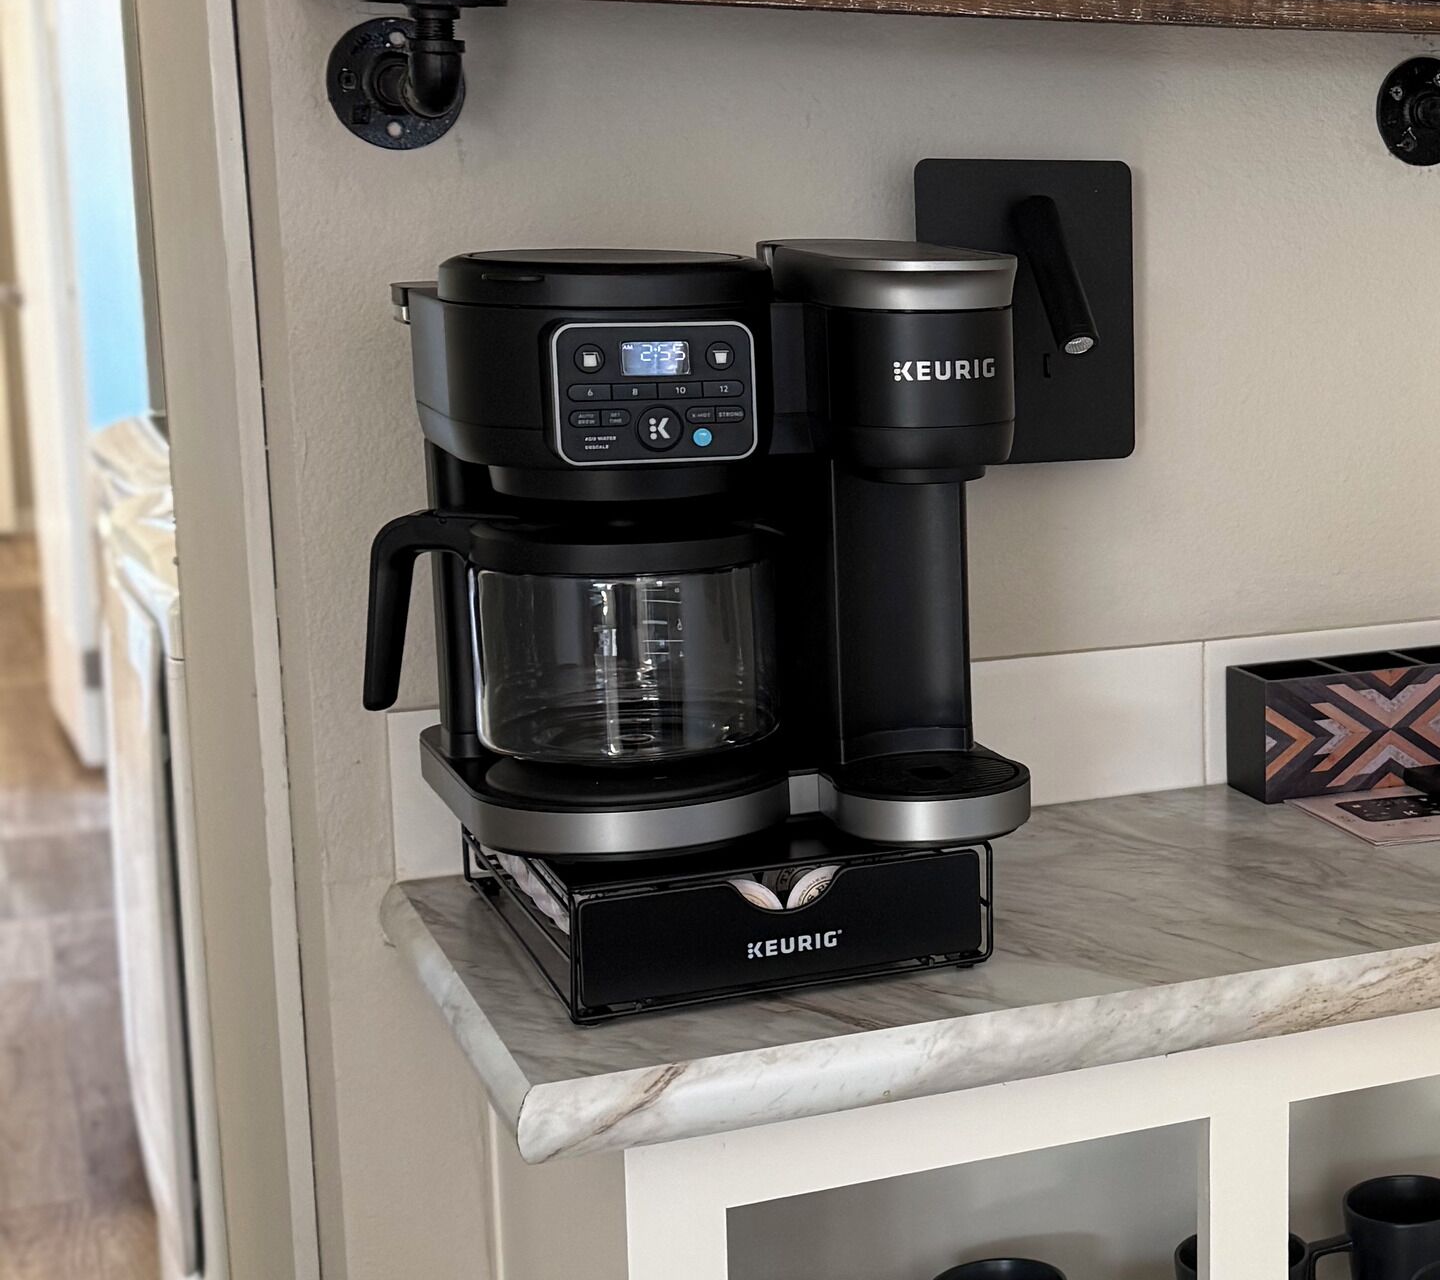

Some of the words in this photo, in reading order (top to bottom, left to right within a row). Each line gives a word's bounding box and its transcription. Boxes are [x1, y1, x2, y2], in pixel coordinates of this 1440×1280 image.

[641, 343, 686, 362] 2:55
[893, 358, 995, 381] KEURIG
[587, 389, 594, 397] 6
[632, 388, 639, 397] 8
[675, 386, 686, 394] 10
[719, 385, 729, 393] 12
[747, 930, 838, 959] KEURIG
